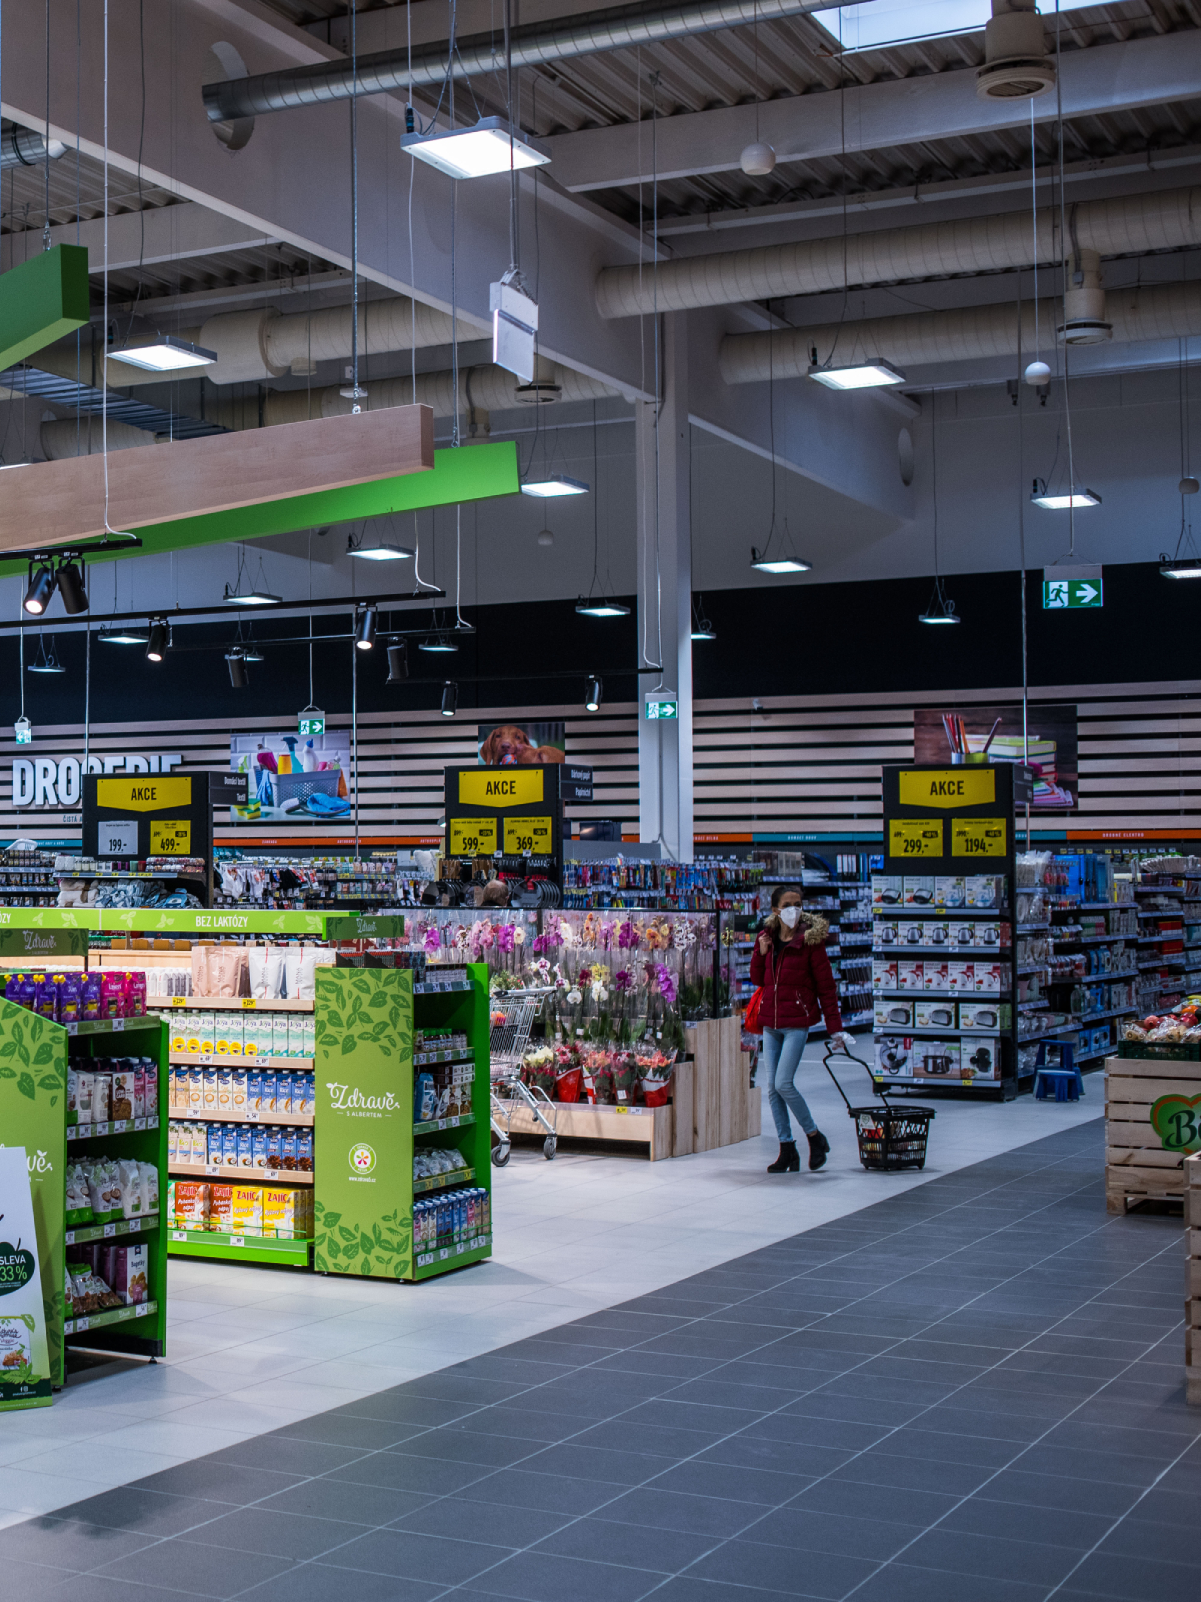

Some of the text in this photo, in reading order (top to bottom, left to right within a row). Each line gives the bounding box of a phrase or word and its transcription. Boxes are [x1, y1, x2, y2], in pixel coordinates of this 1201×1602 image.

[131, 788, 157, 801] AKCE
[486, 780, 516, 795] AKCE
[930, 780, 965, 796] AKCE
[196, 913, 248, 928] BEZ LAKTÓZY
[22, 930, 57, 950] Zdravě
[326, 1082, 400, 1110] Zdravě
[237, 1190, 257, 1201] ZAJÍC
[268, 1192, 288, 1203] ZAJÍC
